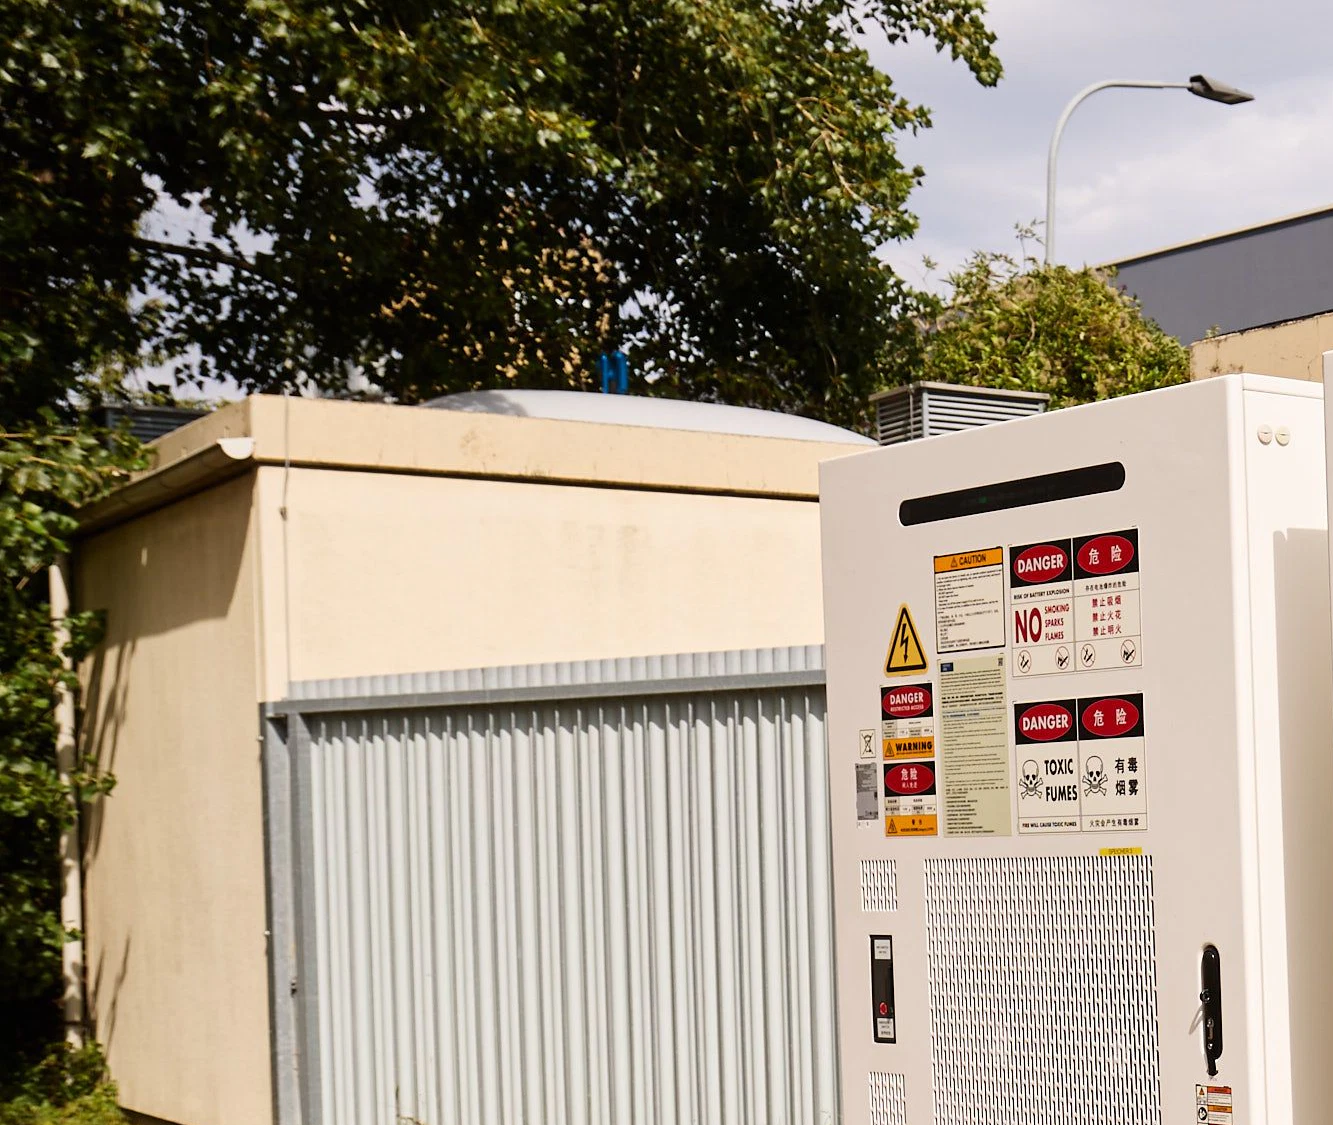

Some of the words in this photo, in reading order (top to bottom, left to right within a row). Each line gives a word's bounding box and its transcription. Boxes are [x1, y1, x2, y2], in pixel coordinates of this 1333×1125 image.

[959, 554, 986, 565] CAUTION
[1089, 545, 1122, 565] 危险
[1018, 554, 1064, 573] DANGER
[1044, 603, 1069, 614] SMOKING
[1015, 607, 1042, 643] NO
[1045, 618, 1064, 627] SPARKS
[1045, 631, 1064, 640] FLAMES
[890, 691, 924, 705] DANGER
[1022, 714, 1069, 731] DANGER
[1093, 707, 1127, 726] 危险
[895, 741, 932, 752] WARNING
[1044, 758, 1073, 775] TOXIC
[1114, 757, 1138, 774] 有毒
[901, 768, 917, 781] 危险
[1045, 785, 1077, 801] FUMES
[1115, 779, 1138, 796] 烟雾
